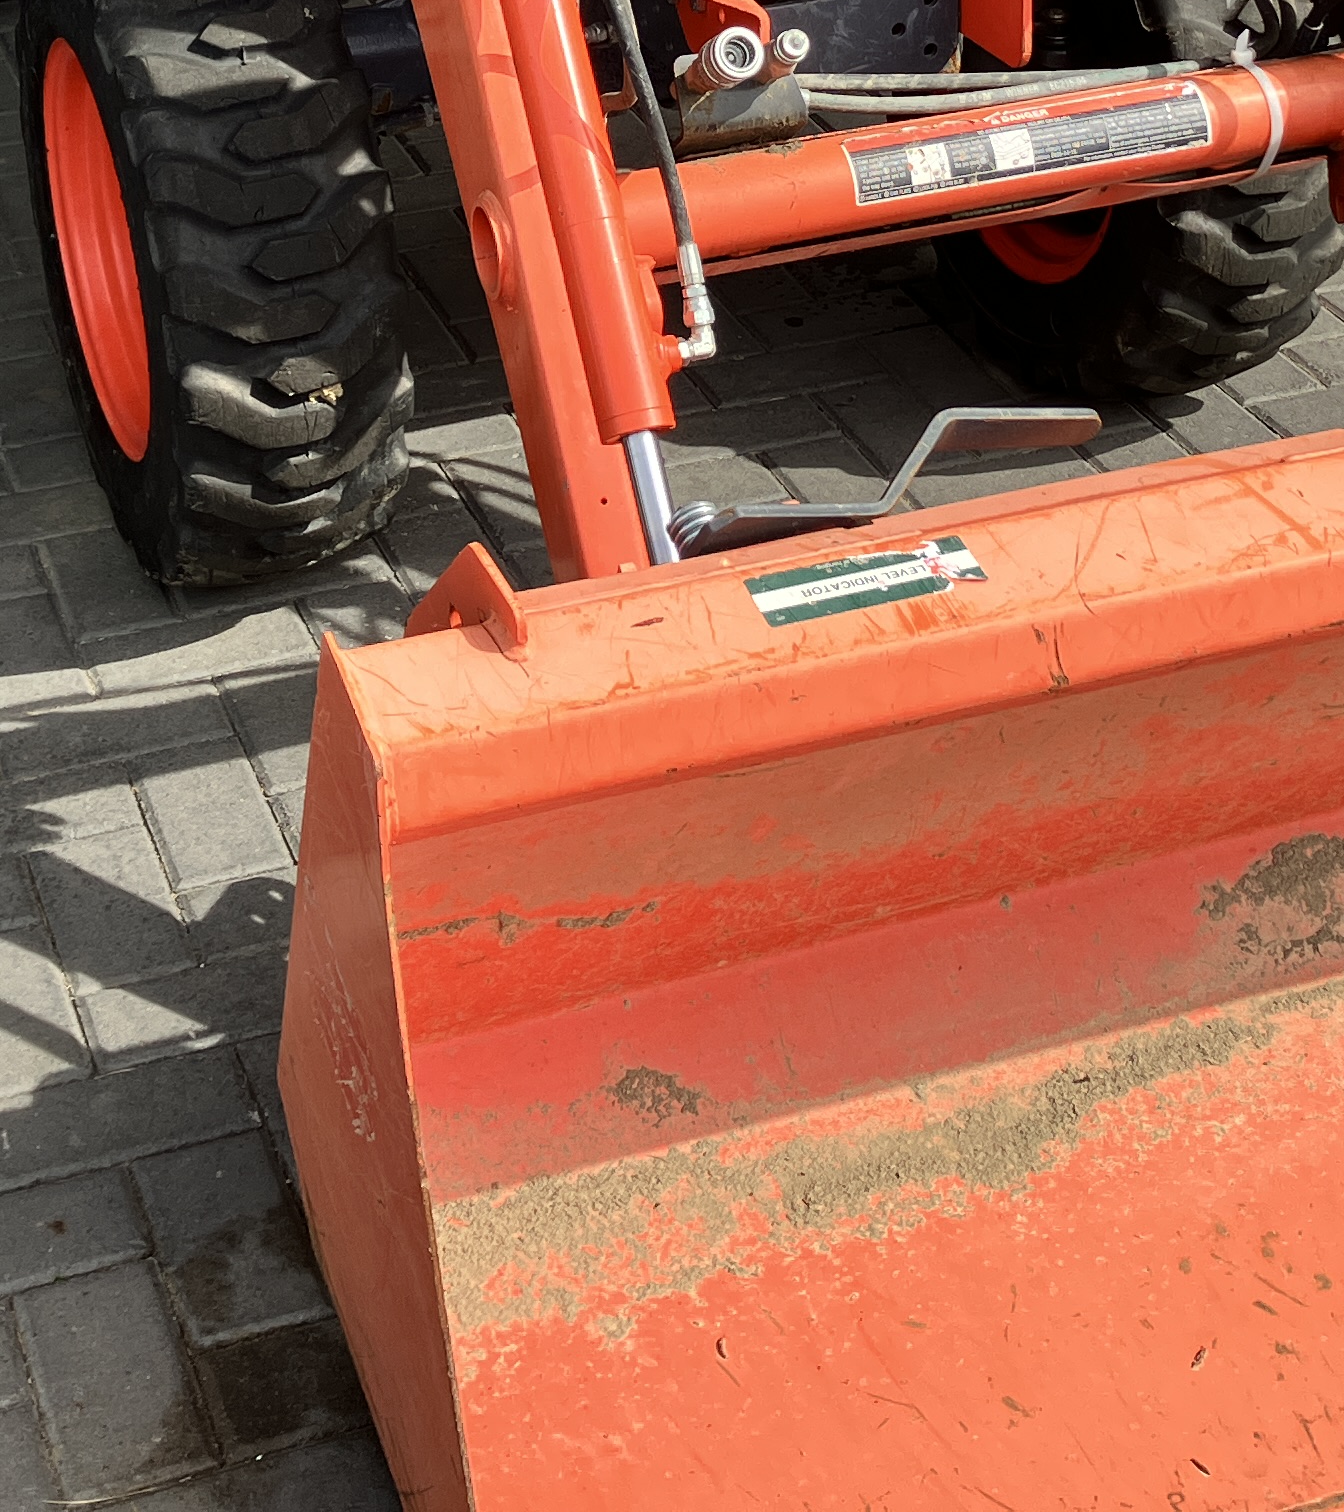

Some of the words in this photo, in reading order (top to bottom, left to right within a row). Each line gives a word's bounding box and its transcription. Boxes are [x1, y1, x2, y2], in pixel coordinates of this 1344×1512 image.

[999, 108, 1050, 123] DANGER
[881, 563, 927, 581] LEVEL
[800, 574, 880, 598] INDICATOR
